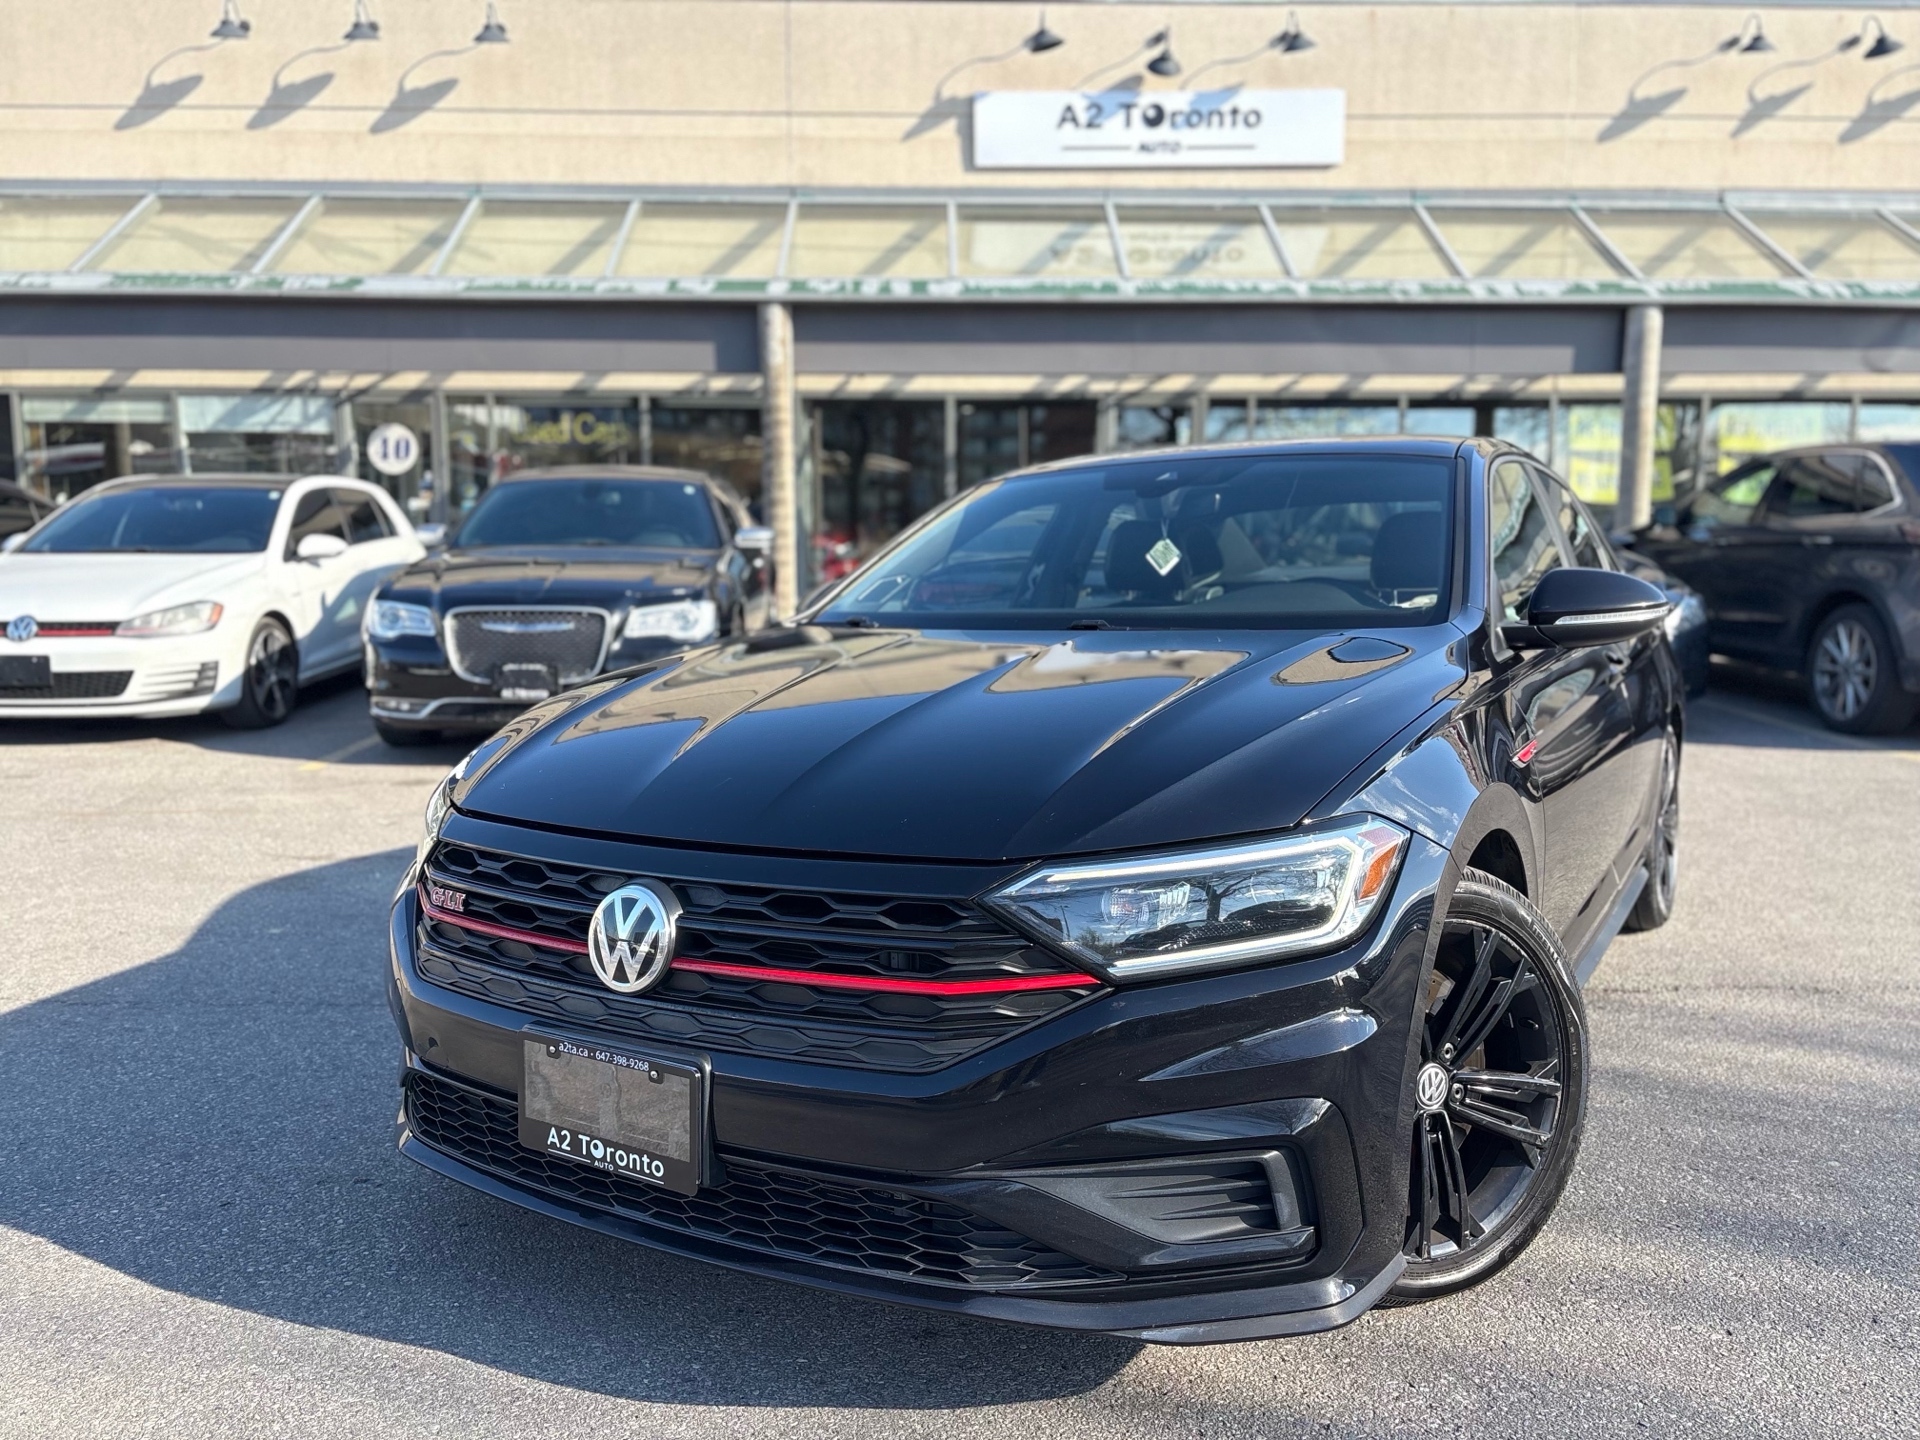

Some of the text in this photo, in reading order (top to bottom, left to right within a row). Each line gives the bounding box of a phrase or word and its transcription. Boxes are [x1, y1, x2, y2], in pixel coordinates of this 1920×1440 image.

[1056, 103, 1103, 130] A2
[378, 435, 411, 460] 10
[430, 886, 466, 912] GLI
[558, 1042, 649, 1072] a2ta.ca 647-398-9268
[547, 1126, 571, 1151] A2
[594, 1160, 614, 1171] AUTO
